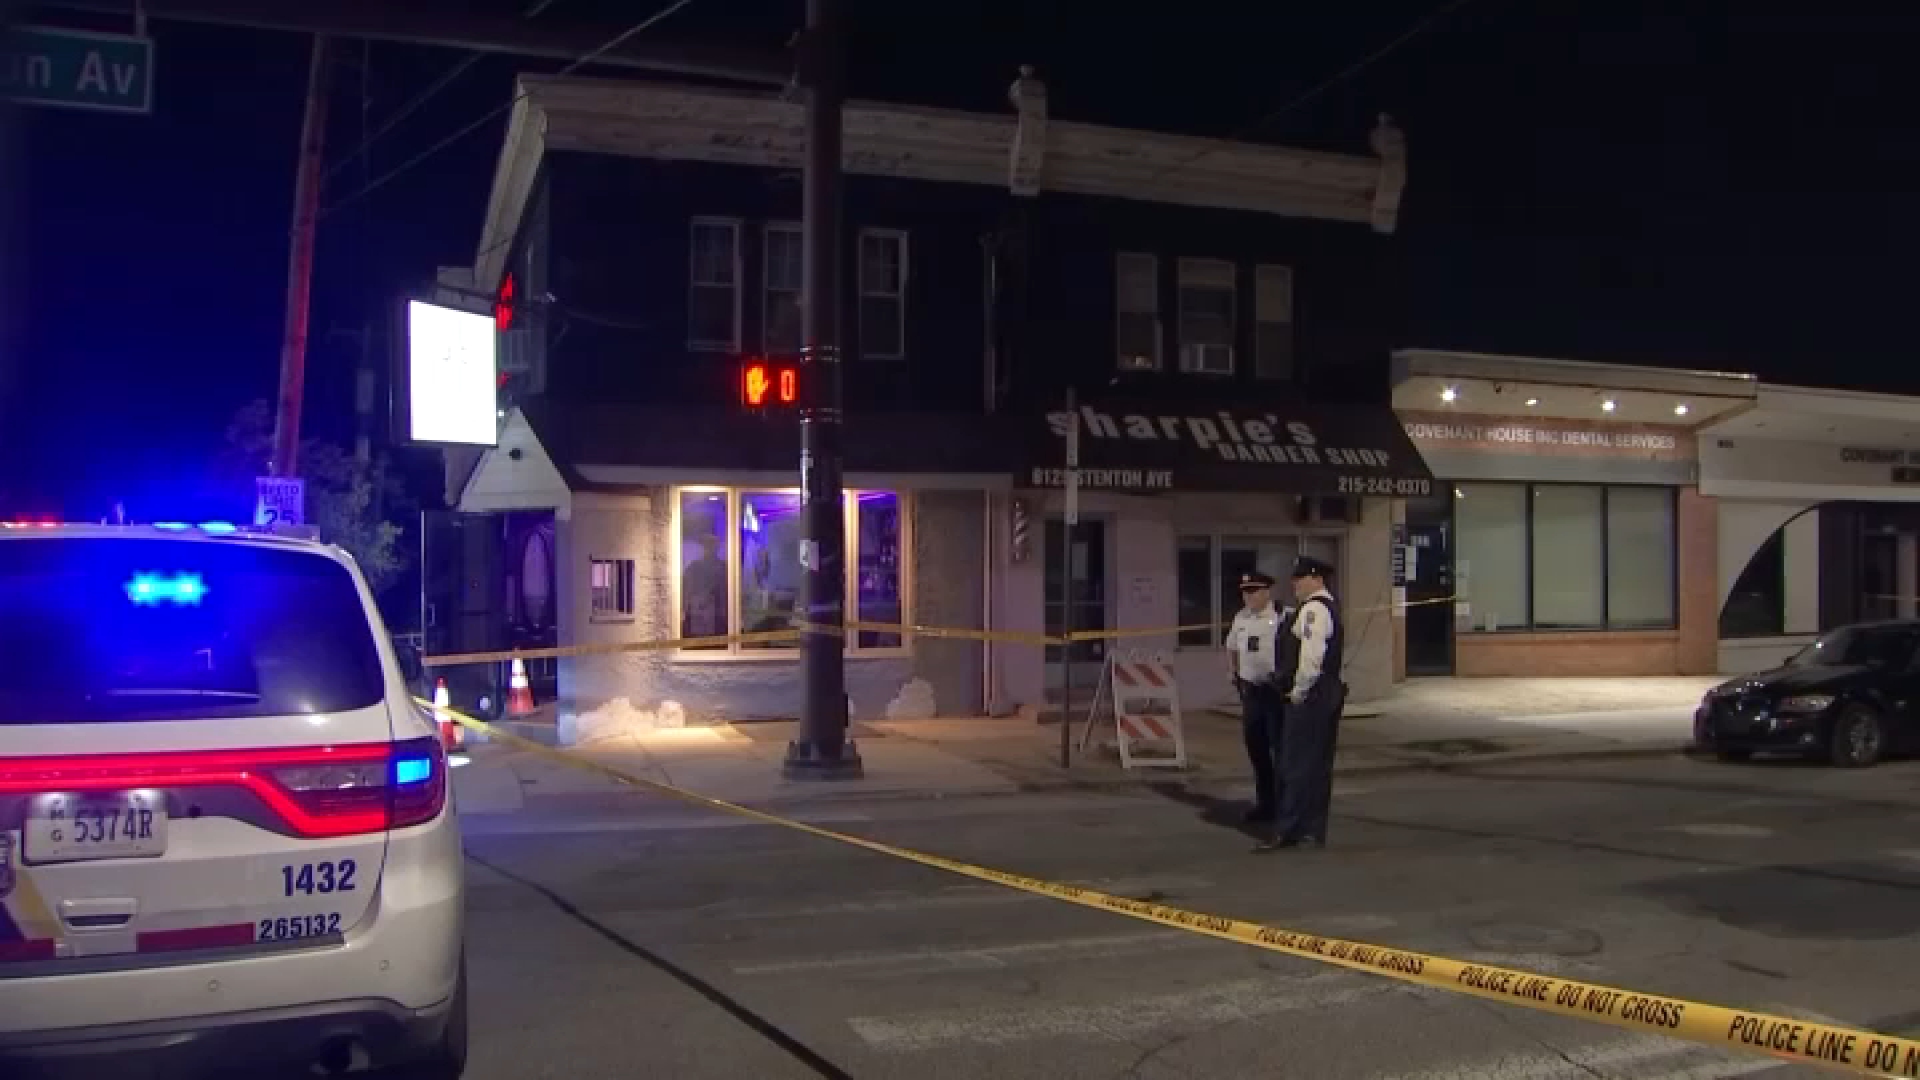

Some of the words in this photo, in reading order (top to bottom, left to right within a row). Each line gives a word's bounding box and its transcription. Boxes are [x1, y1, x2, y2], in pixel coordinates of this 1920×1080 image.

[75, 50, 137, 95] Av
[780, 369, 796, 402] 0
[1045, 405, 1318, 451] sharpie's
[1486, 426, 1534, 443] HOUSE
[1562, 431, 1612, 447] DENTAL
[1615, 433, 1676, 449] SERVICES
[1216, 442, 1320, 464] BARBER
[1325, 446, 1390, 466] SHOP
[1078, 468, 1142, 488] STENTON
[1146, 470, 1173, 488] AVE
[282, 859, 356, 897] 1432
[260, 912, 342, 940] 265132
[1456, 965, 1515, 993] POLICE
[1512, 976, 1555, 1001] LINE
[1556, 983, 1585, 1008] DO
[1582, 988, 1622, 1016] NOT
[1620, 995, 1686, 1029] CROSS
[1727, 1014, 1804, 1053] POLICE
[1804, 1029, 1858, 1065] LINE
[1863, 1038, 1900, 1073] DO
